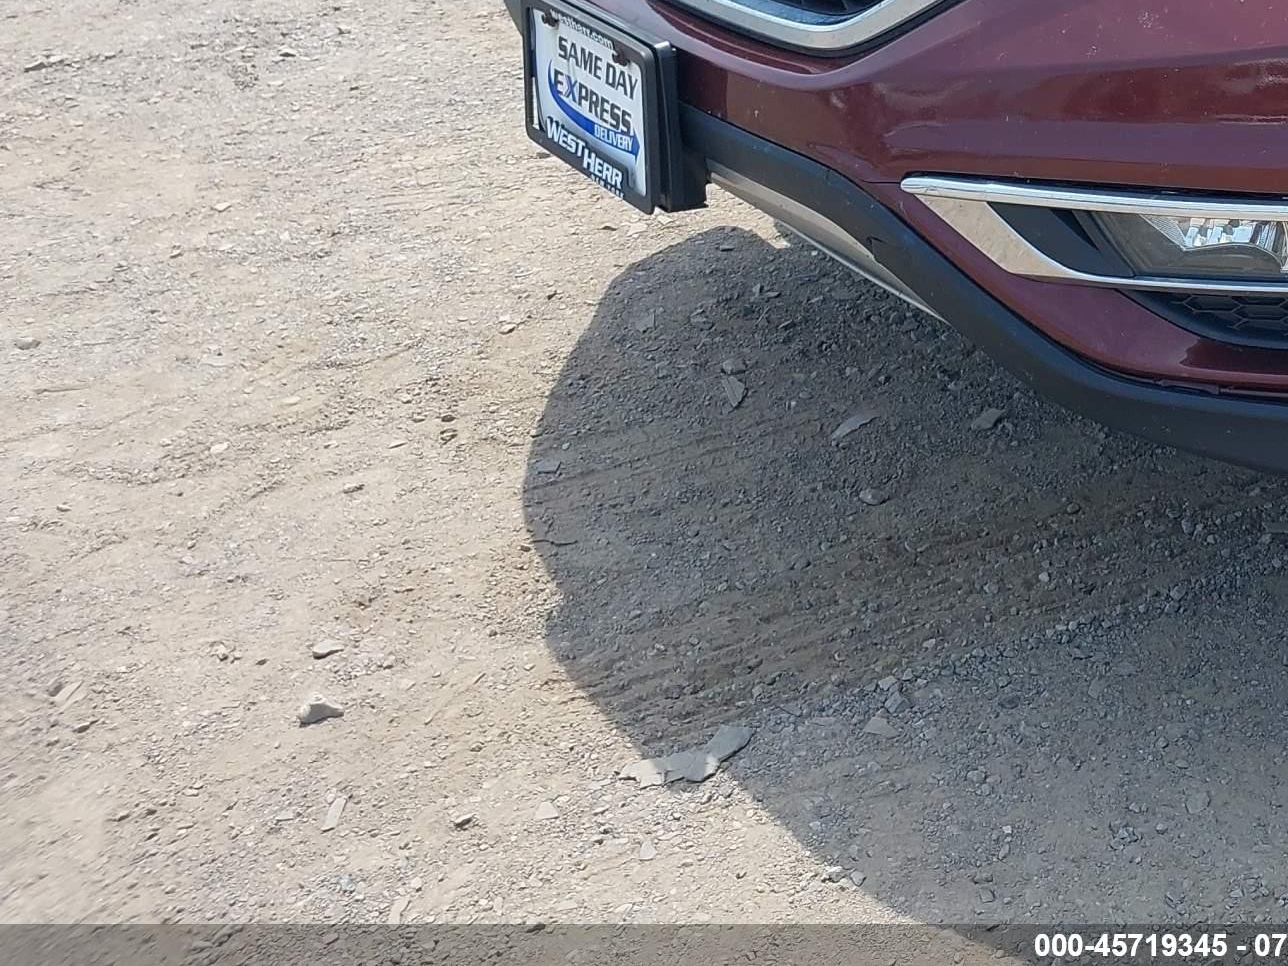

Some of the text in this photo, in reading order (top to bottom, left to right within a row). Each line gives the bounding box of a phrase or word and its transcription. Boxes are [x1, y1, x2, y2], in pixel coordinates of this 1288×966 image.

[557, 35, 639, 101] SAME DAY
[552, 67, 633, 136] EXPRESS
[593, 123, 634, 152] DELIVERY
